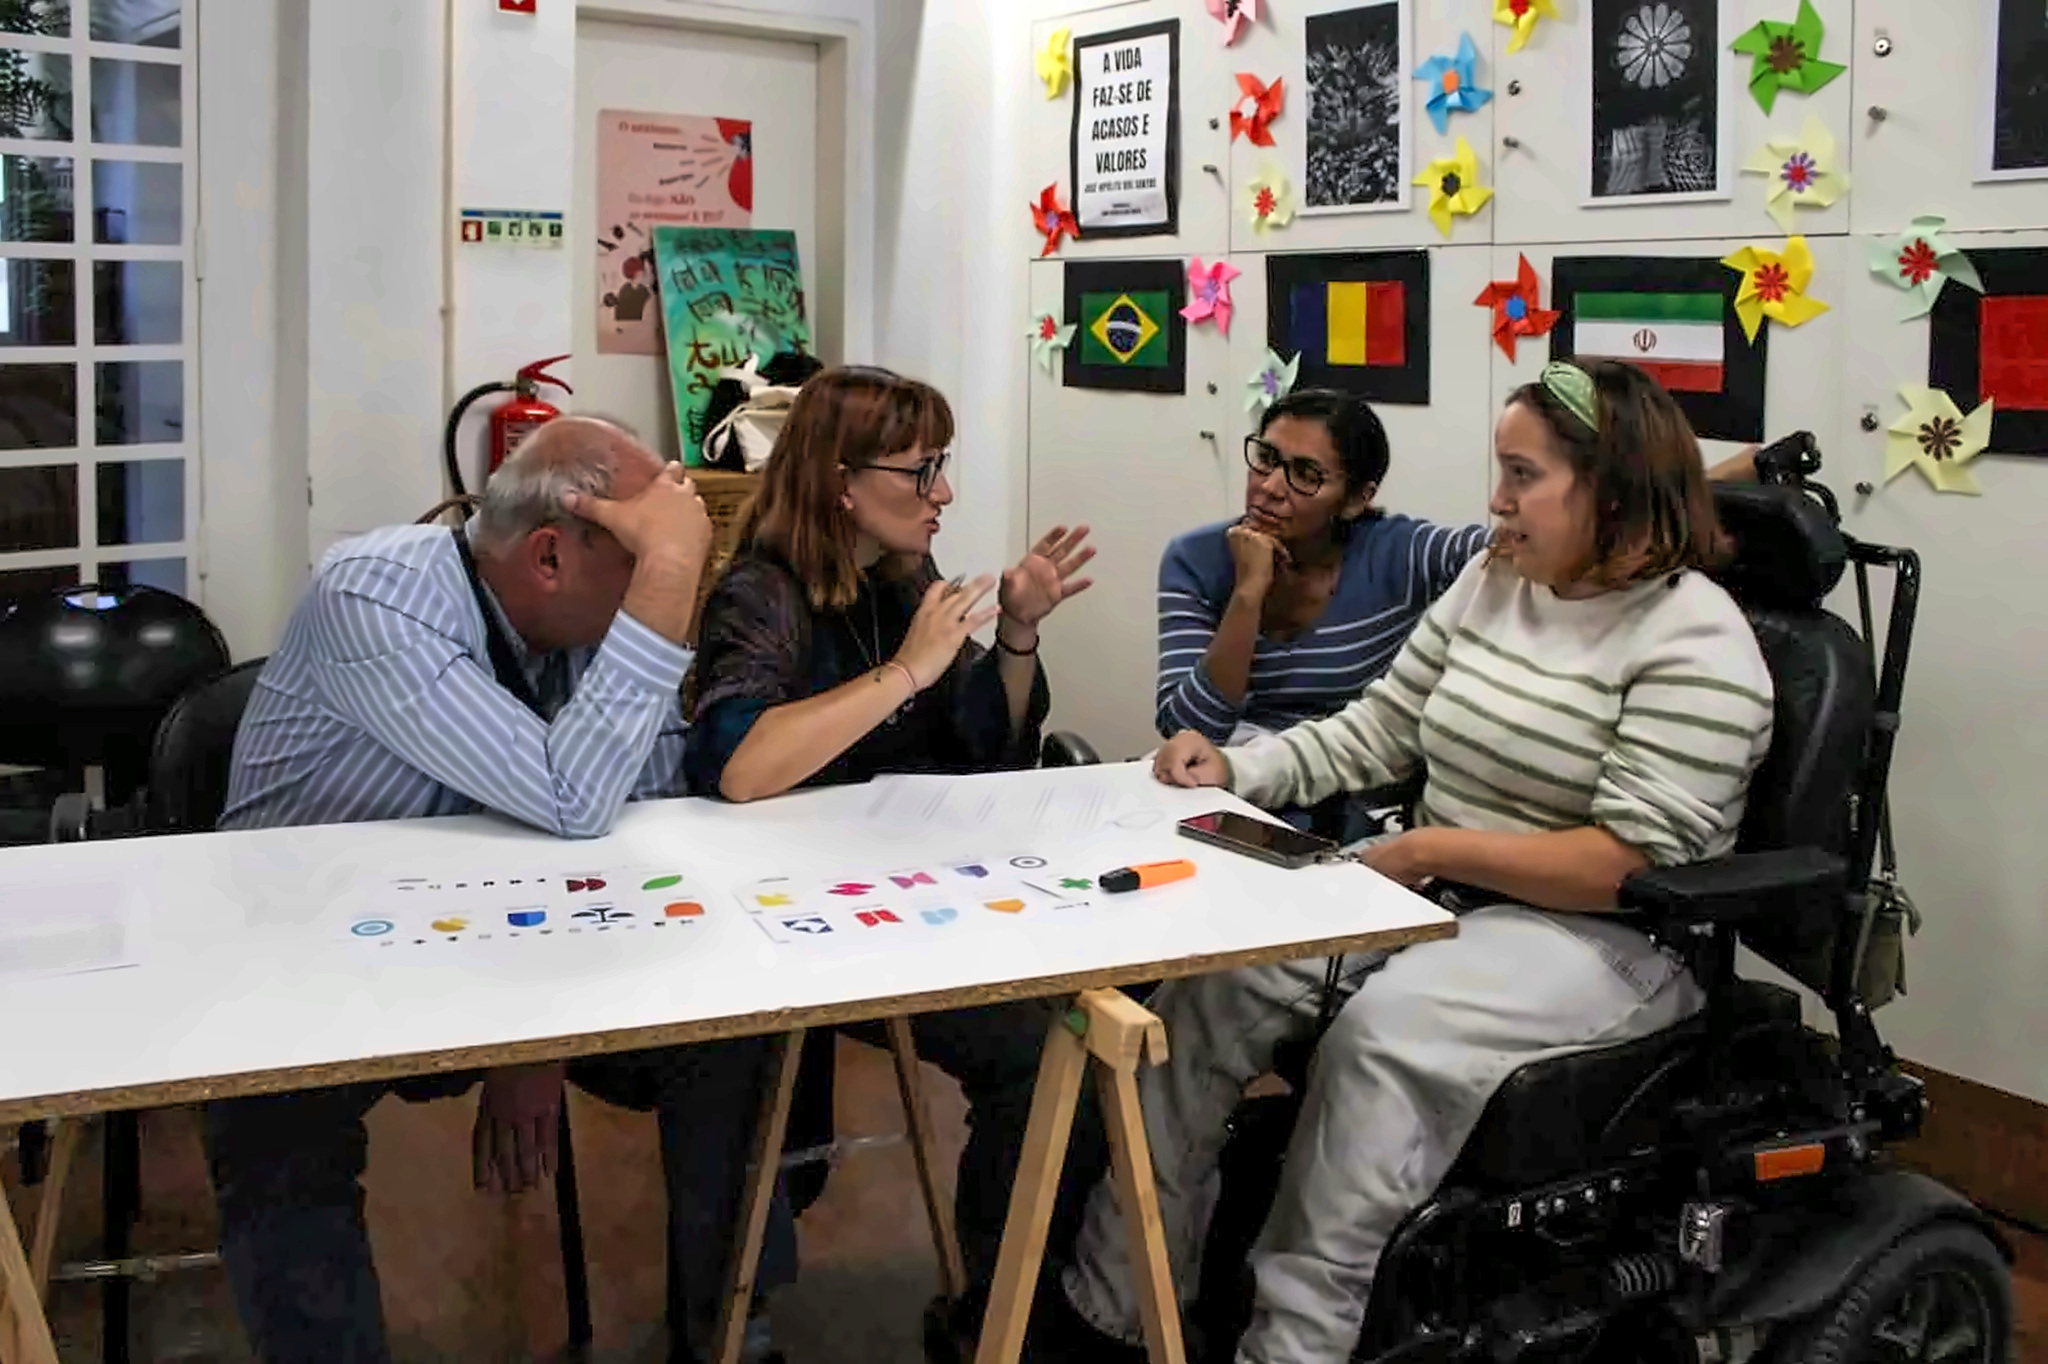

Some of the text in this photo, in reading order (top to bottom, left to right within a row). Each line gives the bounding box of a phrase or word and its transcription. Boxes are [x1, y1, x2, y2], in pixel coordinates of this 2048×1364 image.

[1103, 47, 1142, 73] A VIDA
[1093, 79, 1152, 108] FAZ-SE DE
[1092, 113, 1149, 141] ACASOS E
[1096, 148, 1147, 174] VALORES
